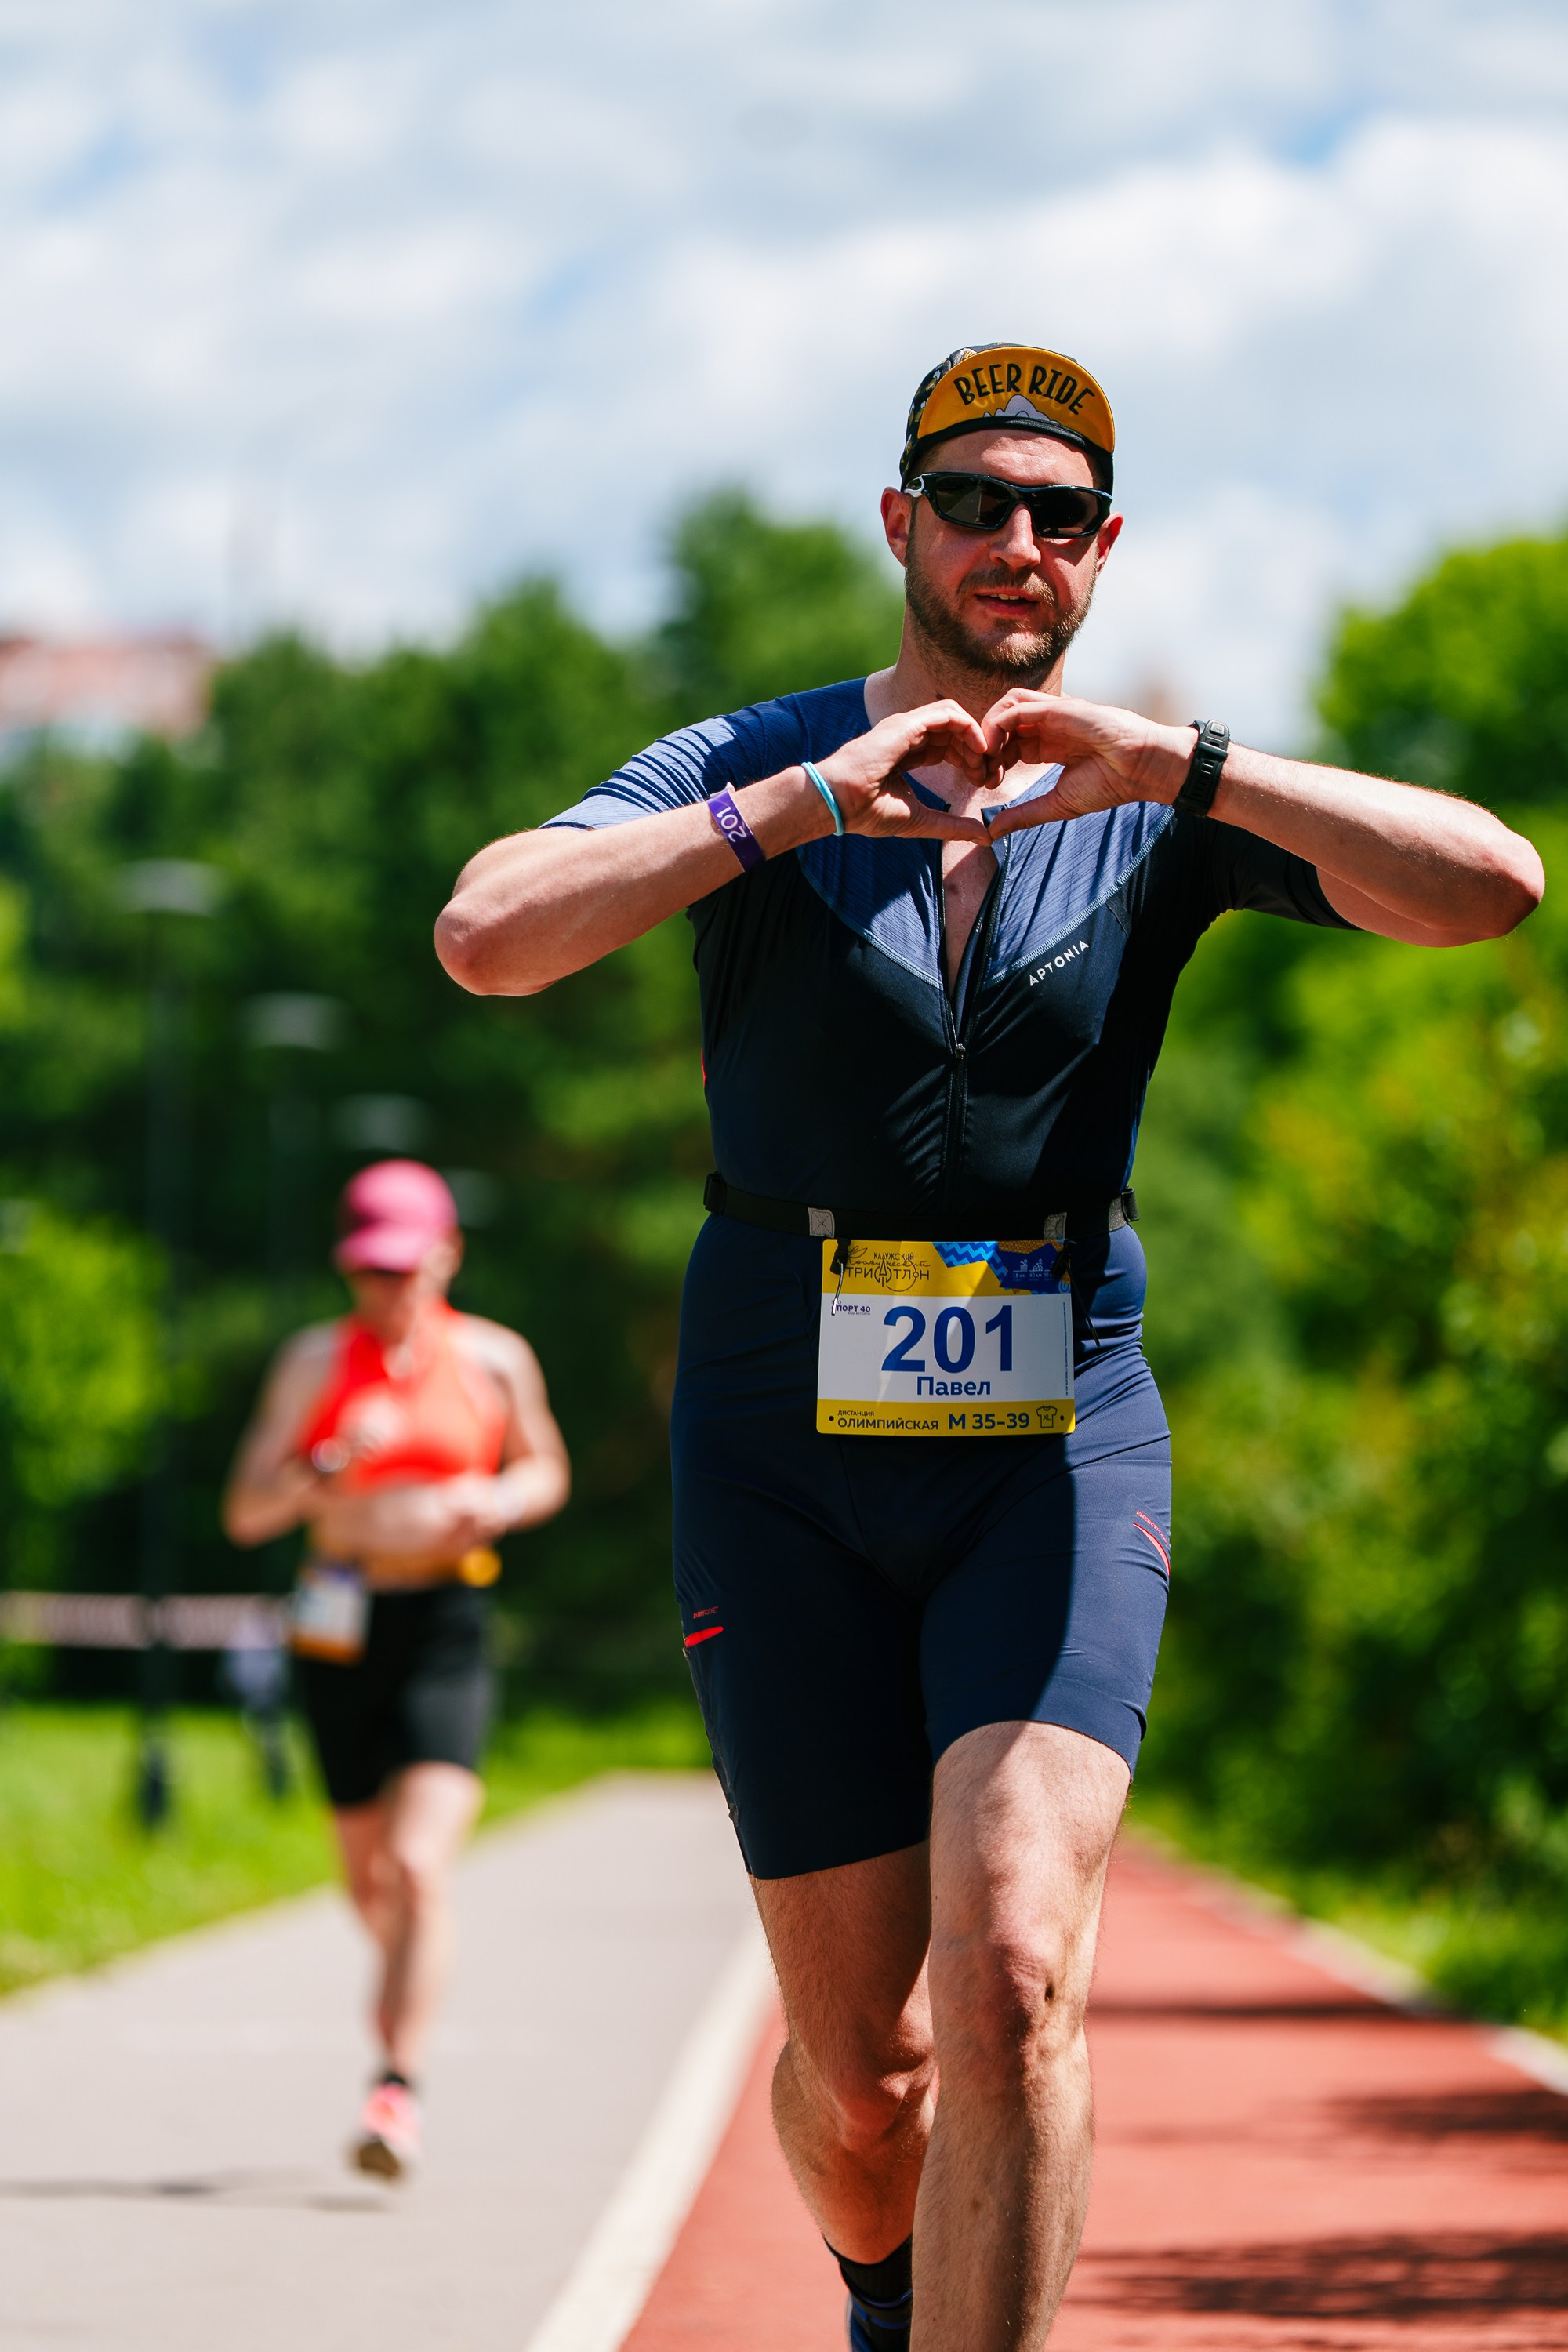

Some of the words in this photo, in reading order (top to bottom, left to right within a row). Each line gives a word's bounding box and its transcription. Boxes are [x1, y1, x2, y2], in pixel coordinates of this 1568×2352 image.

[953, 363, 1022, 405] BEER
[1029, 365, 1095, 415] RIDE
[716, 806, 747, 842] 201
[1029, 939, 1090, 986] APTONIA
[880, 1305, 1013, 1374] 201
[916, 1376, 991, 1396] Павел
[837, 1417, 938, 1430] ОЛИМПИЙСКАЯ
